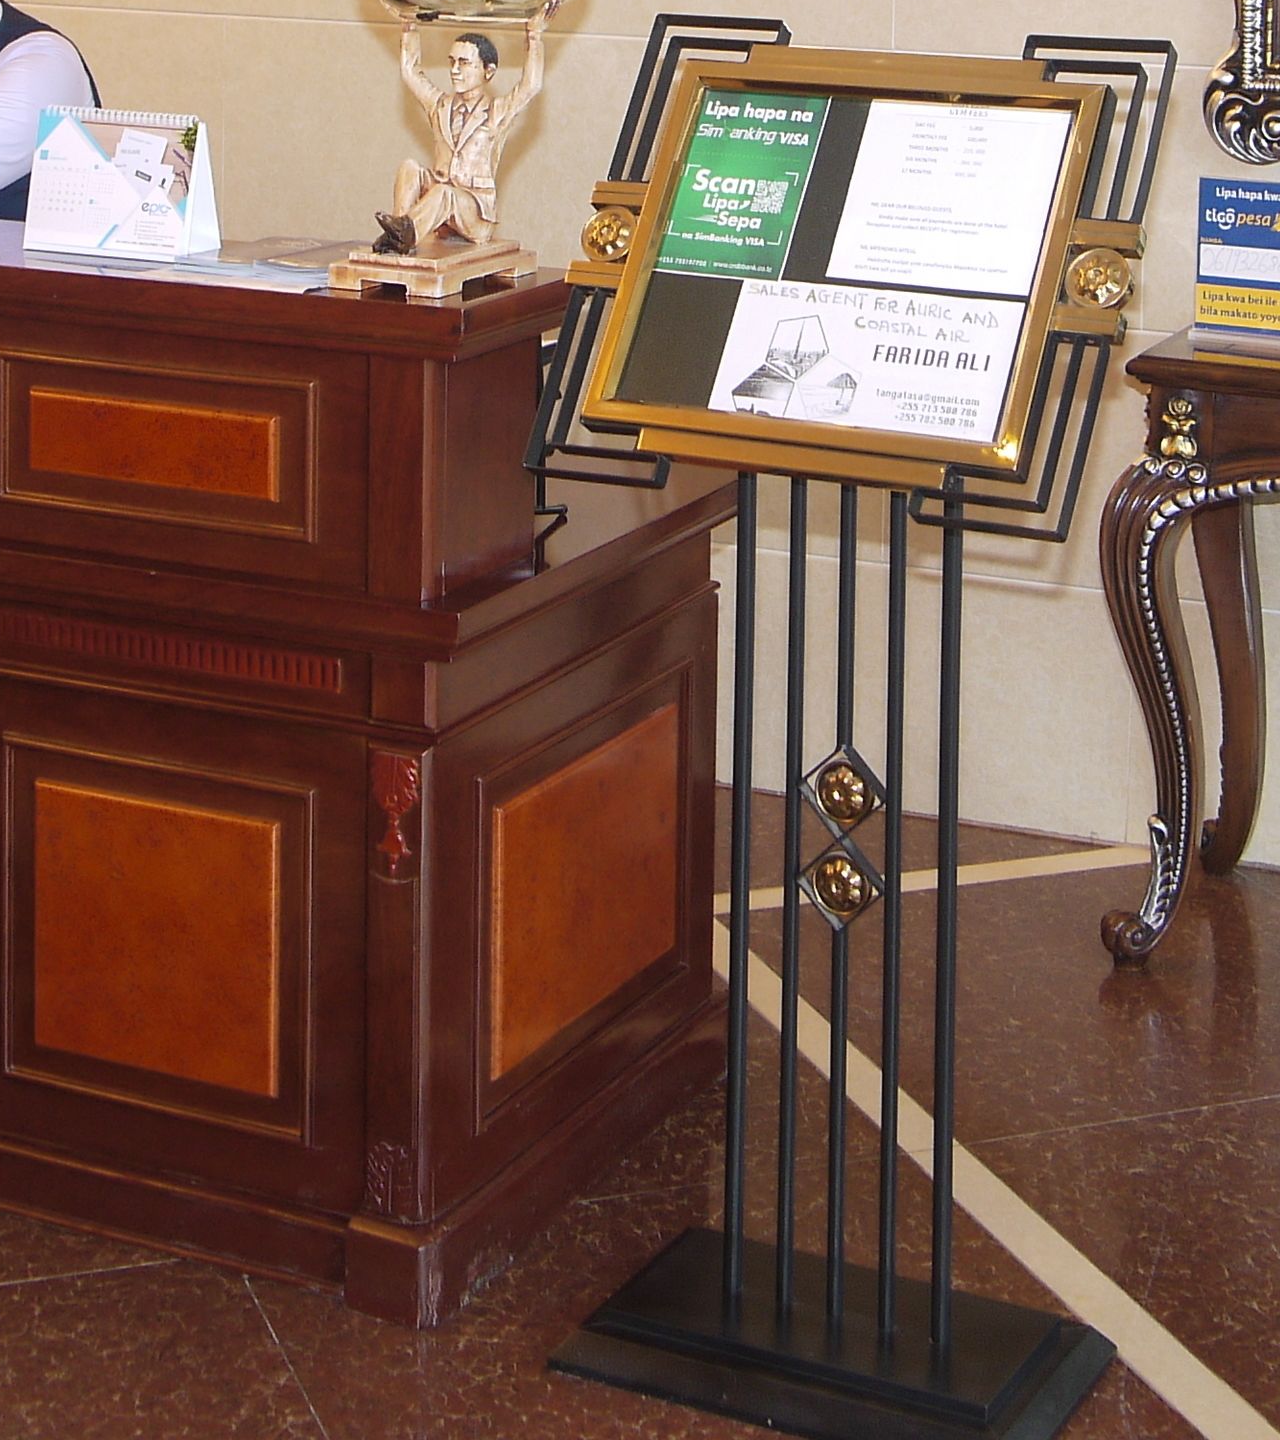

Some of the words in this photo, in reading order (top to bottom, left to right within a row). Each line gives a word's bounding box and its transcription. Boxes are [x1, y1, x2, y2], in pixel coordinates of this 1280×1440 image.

[704, 100, 740, 120] Lipa
[743, 102, 787, 123] hapa
[790, 108, 814, 123] na
[696, 123, 776, 145] Simanking
[779, 131, 809, 146] VISA
[692, 168, 756, 196] Scan
[702, 193, 741, 213] Lipa
[1215, 186, 1237, 201] Lipa
[1238, 187, 1263, 203] hapa
[716, 210, 762, 233] Sepa
[1235, 212, 1272, 228] pesa
[681, 232, 693, 241] na
[694, 232, 744, 247] SimBanking
[745, 235, 765, 247] VISA
[748, 283, 800, 300] SALES
[805, 288, 869, 311] AGENT
[873, 297, 900, 316] FOR
[904, 298, 953, 322] AURIC
[961, 308, 999, 329] AND
[1202, 290, 1224, 303] Lipa
[1226, 292, 1246, 304] kwa
[1248, 294, 1263, 305] bei
[1265, 296, 1278, 307] ile
[1199, 305, 1218, 316] bila
[1220, 308, 1259, 320] makato
[855, 316, 928, 338] COASTAL
[935, 327, 971, 344] AIR
[872, 344, 951, 369] FARIDA
[955, 353, 991, 372] ALI
